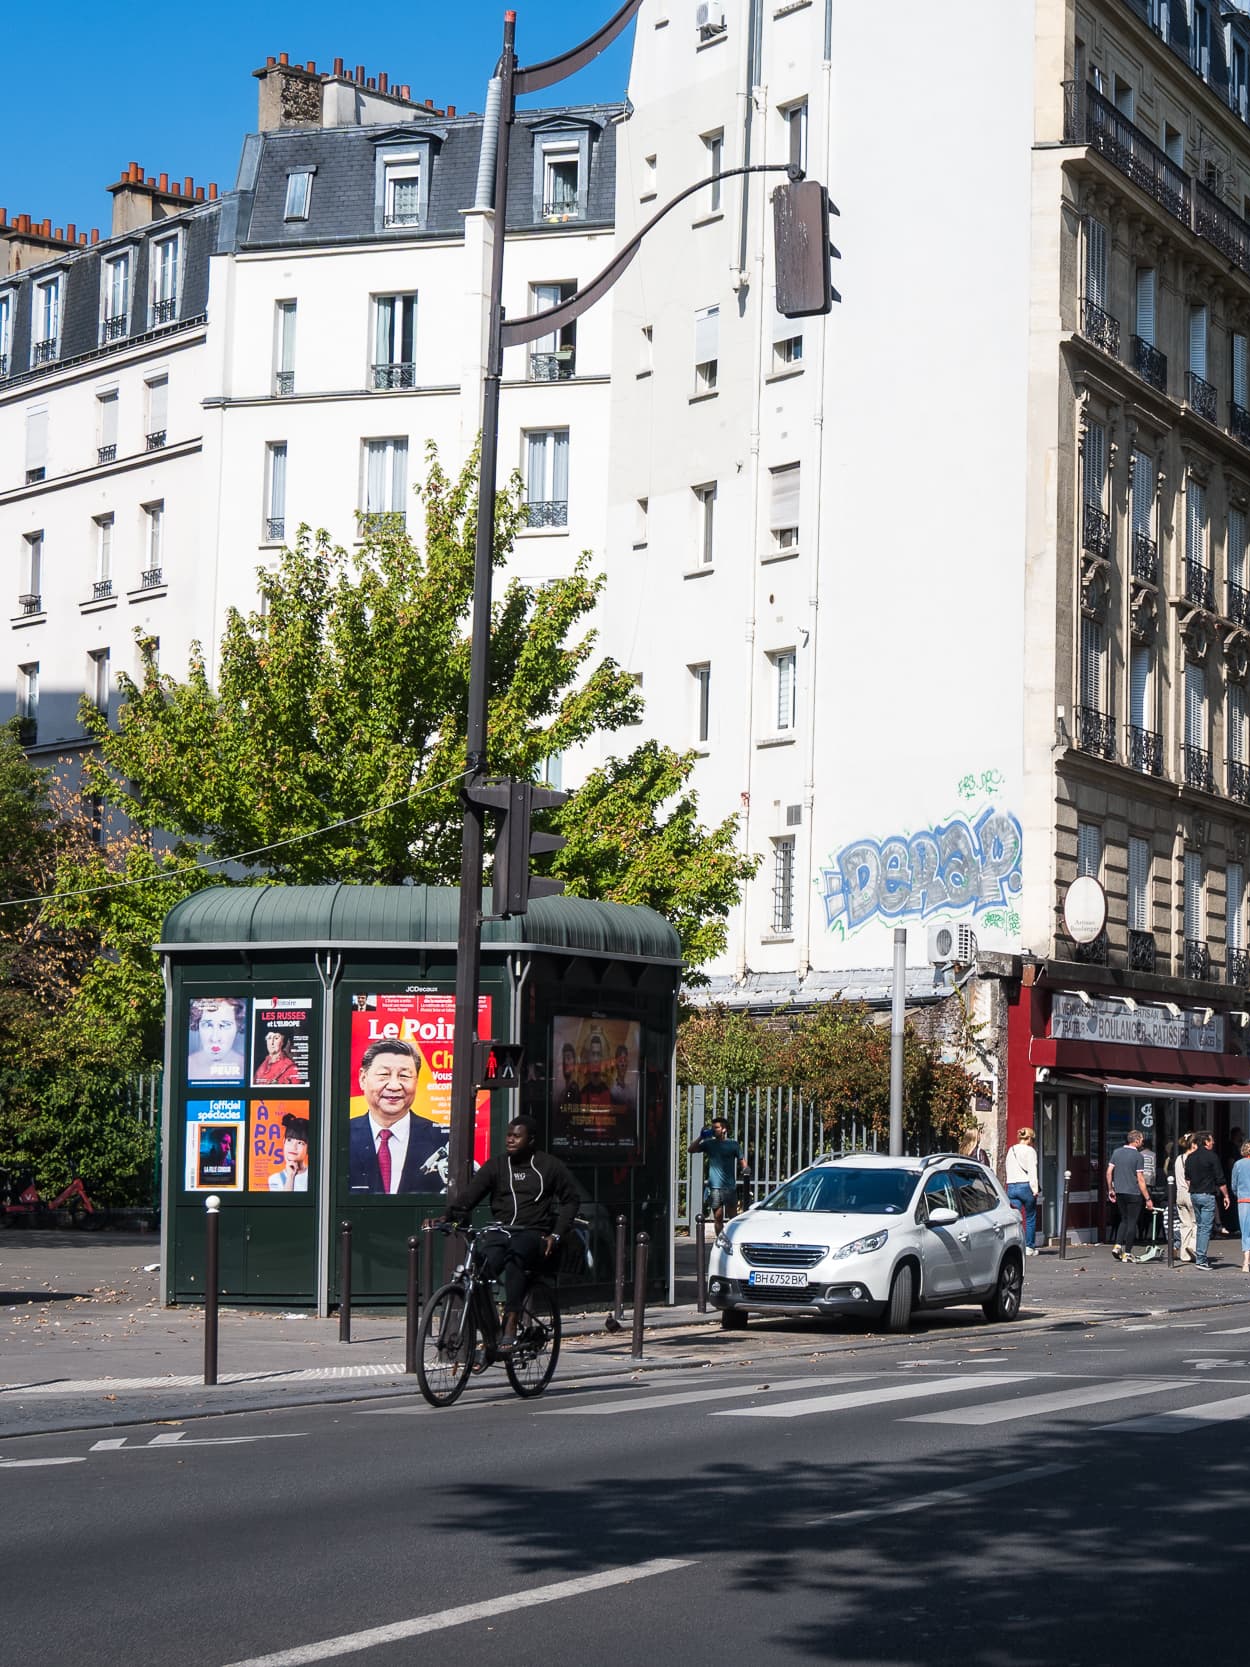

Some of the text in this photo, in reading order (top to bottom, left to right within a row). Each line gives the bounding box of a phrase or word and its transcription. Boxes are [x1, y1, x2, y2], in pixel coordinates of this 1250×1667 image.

[262, 1011, 306, 1020] LES RUSSES
[368, 1017, 455, 1040] Le Poi
[1099, 1017, 1146, 1040] BOULANGER
[431, 1050, 453, 1069] Ch
[432, 1072, 452, 1080] Vous
[427, 1082, 451, 1091] encor
[257, 1099, 268, 1120] À
[755, 1273, 805, 1286] BH 6752 BK
